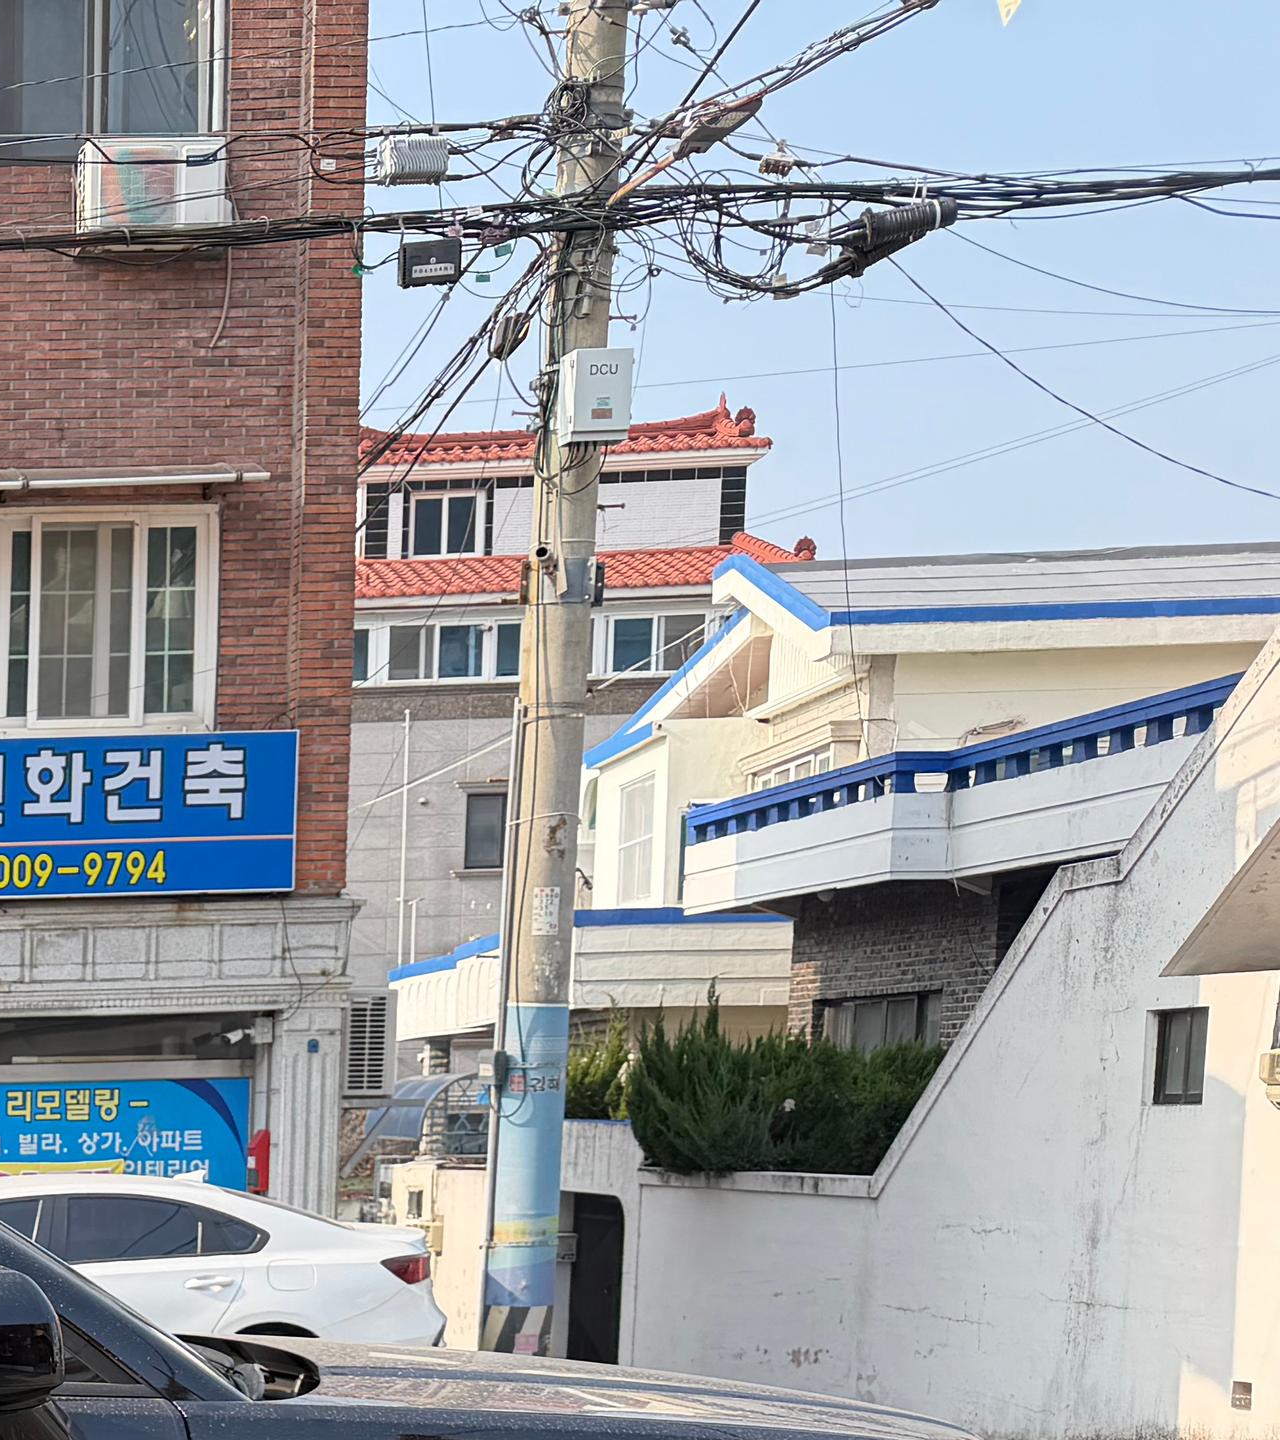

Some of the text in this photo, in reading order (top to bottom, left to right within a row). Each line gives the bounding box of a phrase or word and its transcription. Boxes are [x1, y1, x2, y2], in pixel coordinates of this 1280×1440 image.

[590, 364, 618, 376] DCU
[6, 1088, 121, 1122] 리모델링
[138, 1130, 204, 1153] 아파트
